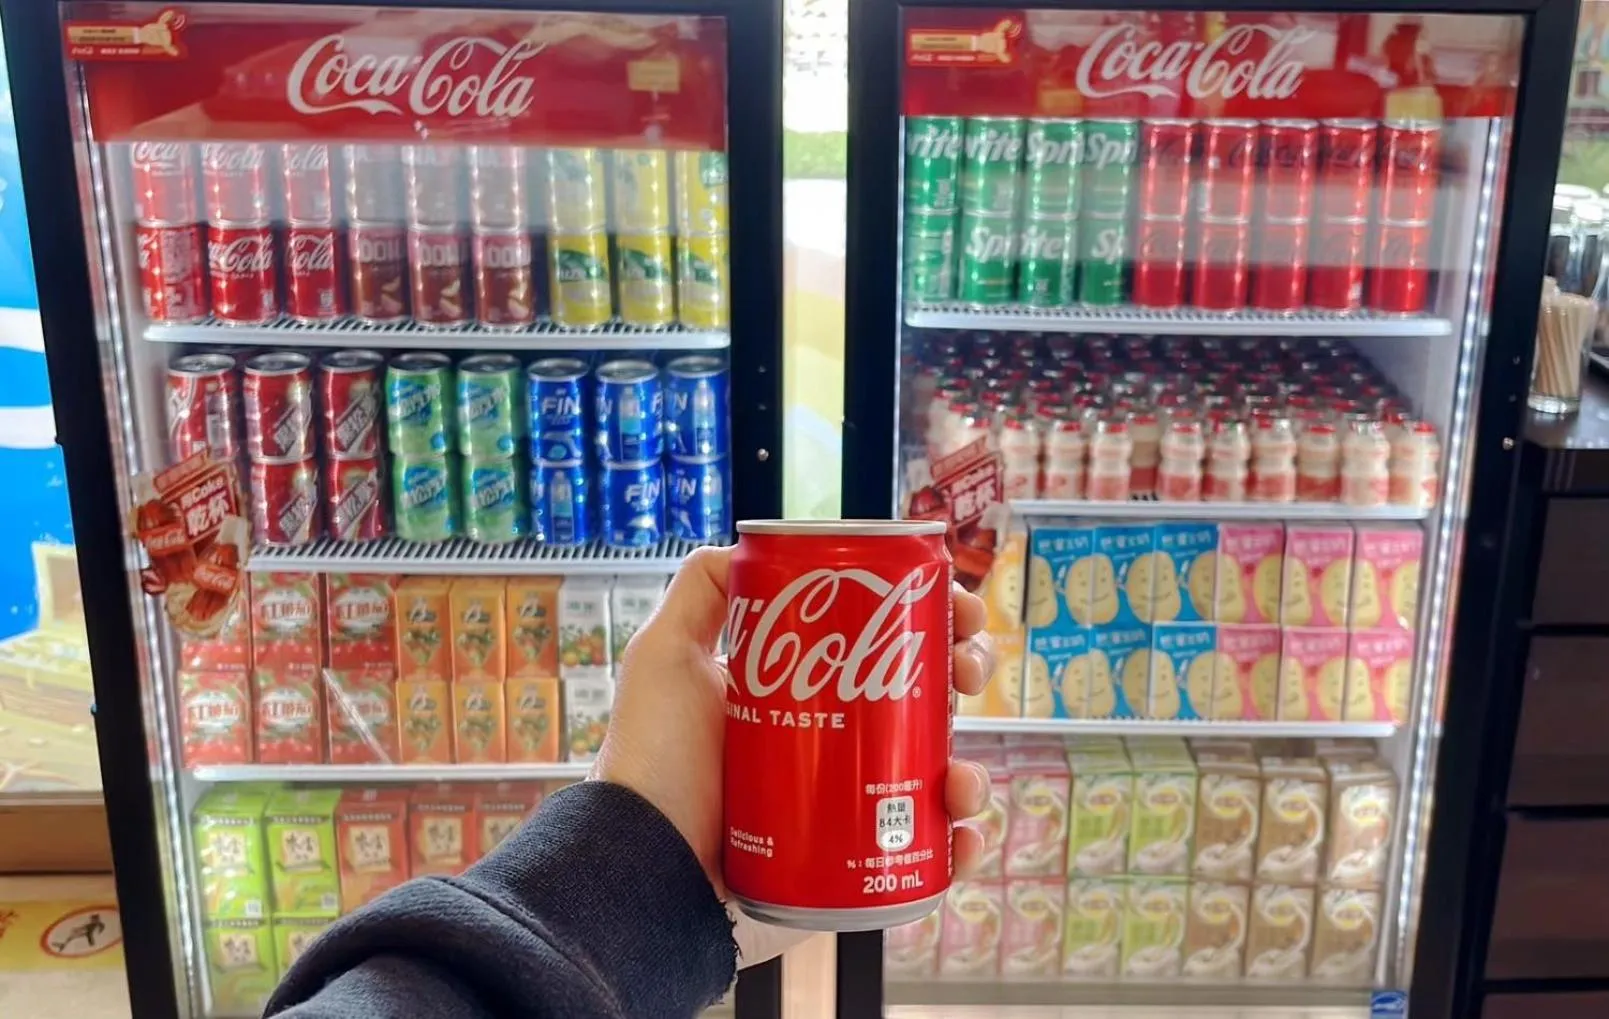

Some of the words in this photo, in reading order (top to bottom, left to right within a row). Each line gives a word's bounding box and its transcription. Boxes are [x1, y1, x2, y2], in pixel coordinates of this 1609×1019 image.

[1076, 23, 1317, 99] Coca-Cola
[287, 34, 547, 117] Coca-Cola
[541, 396, 583, 417] FIN
[625, 479, 661, 504] FIN
[769, 709, 845, 729] TASTE
[888, 834, 903, 844] 4%
[863, 873, 898, 893] 200
[901, 870, 924, 890] mL
